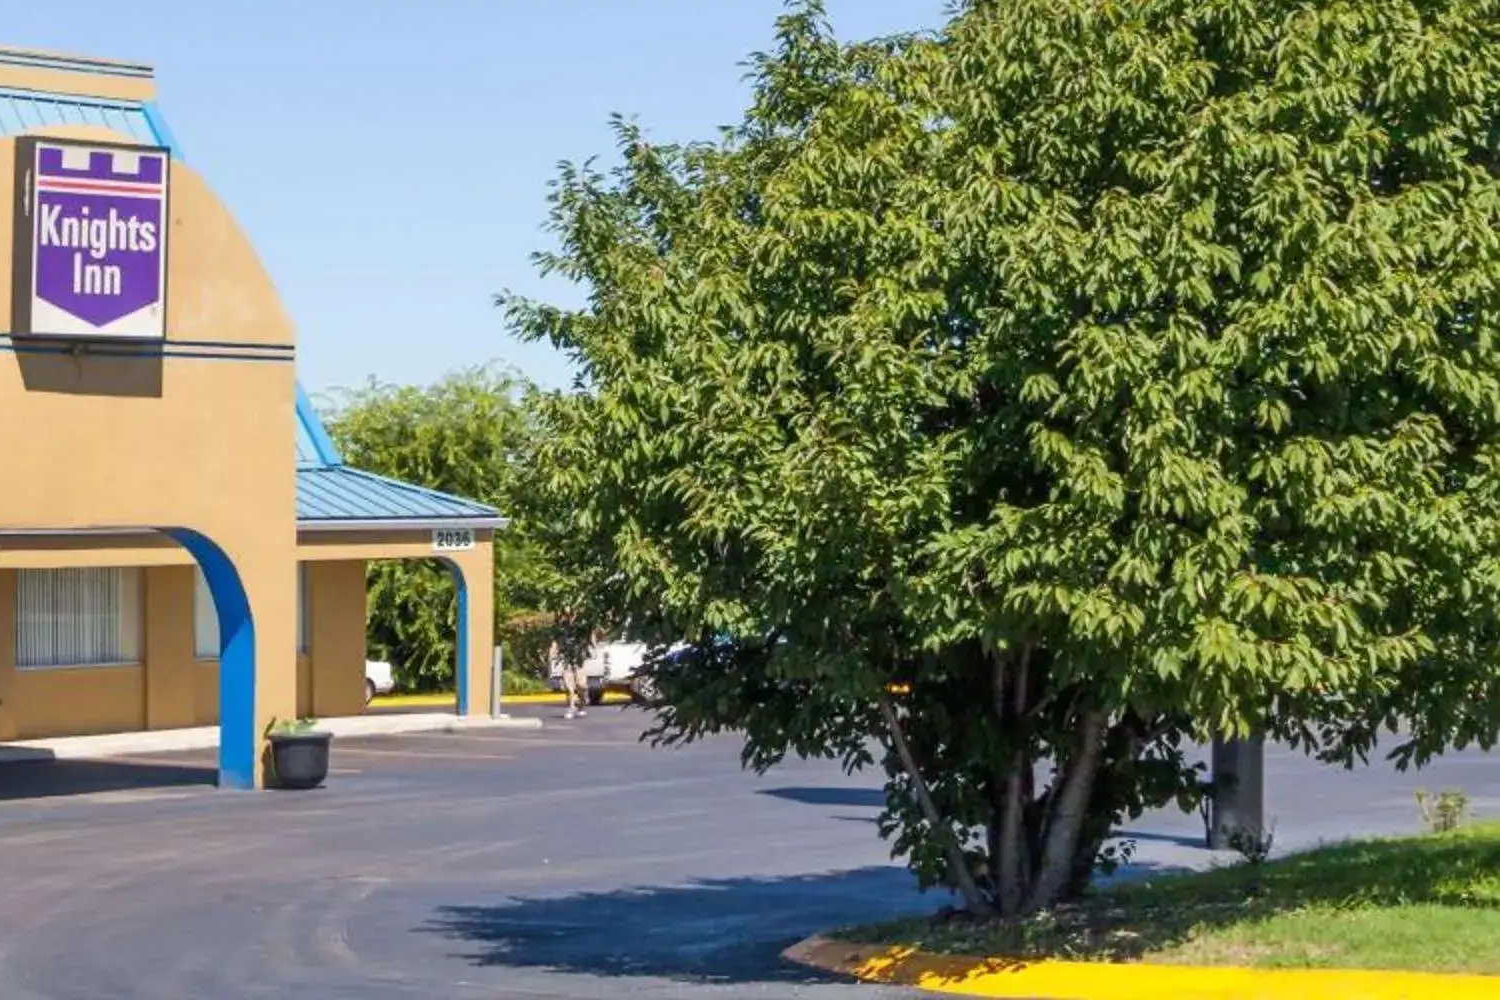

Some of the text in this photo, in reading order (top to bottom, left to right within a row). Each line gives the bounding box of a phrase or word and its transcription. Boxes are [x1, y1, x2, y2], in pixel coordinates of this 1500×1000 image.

[41, 203, 157, 258] Knights
[73, 252, 121, 295] Inn
[436, 530, 471, 547] 2036
